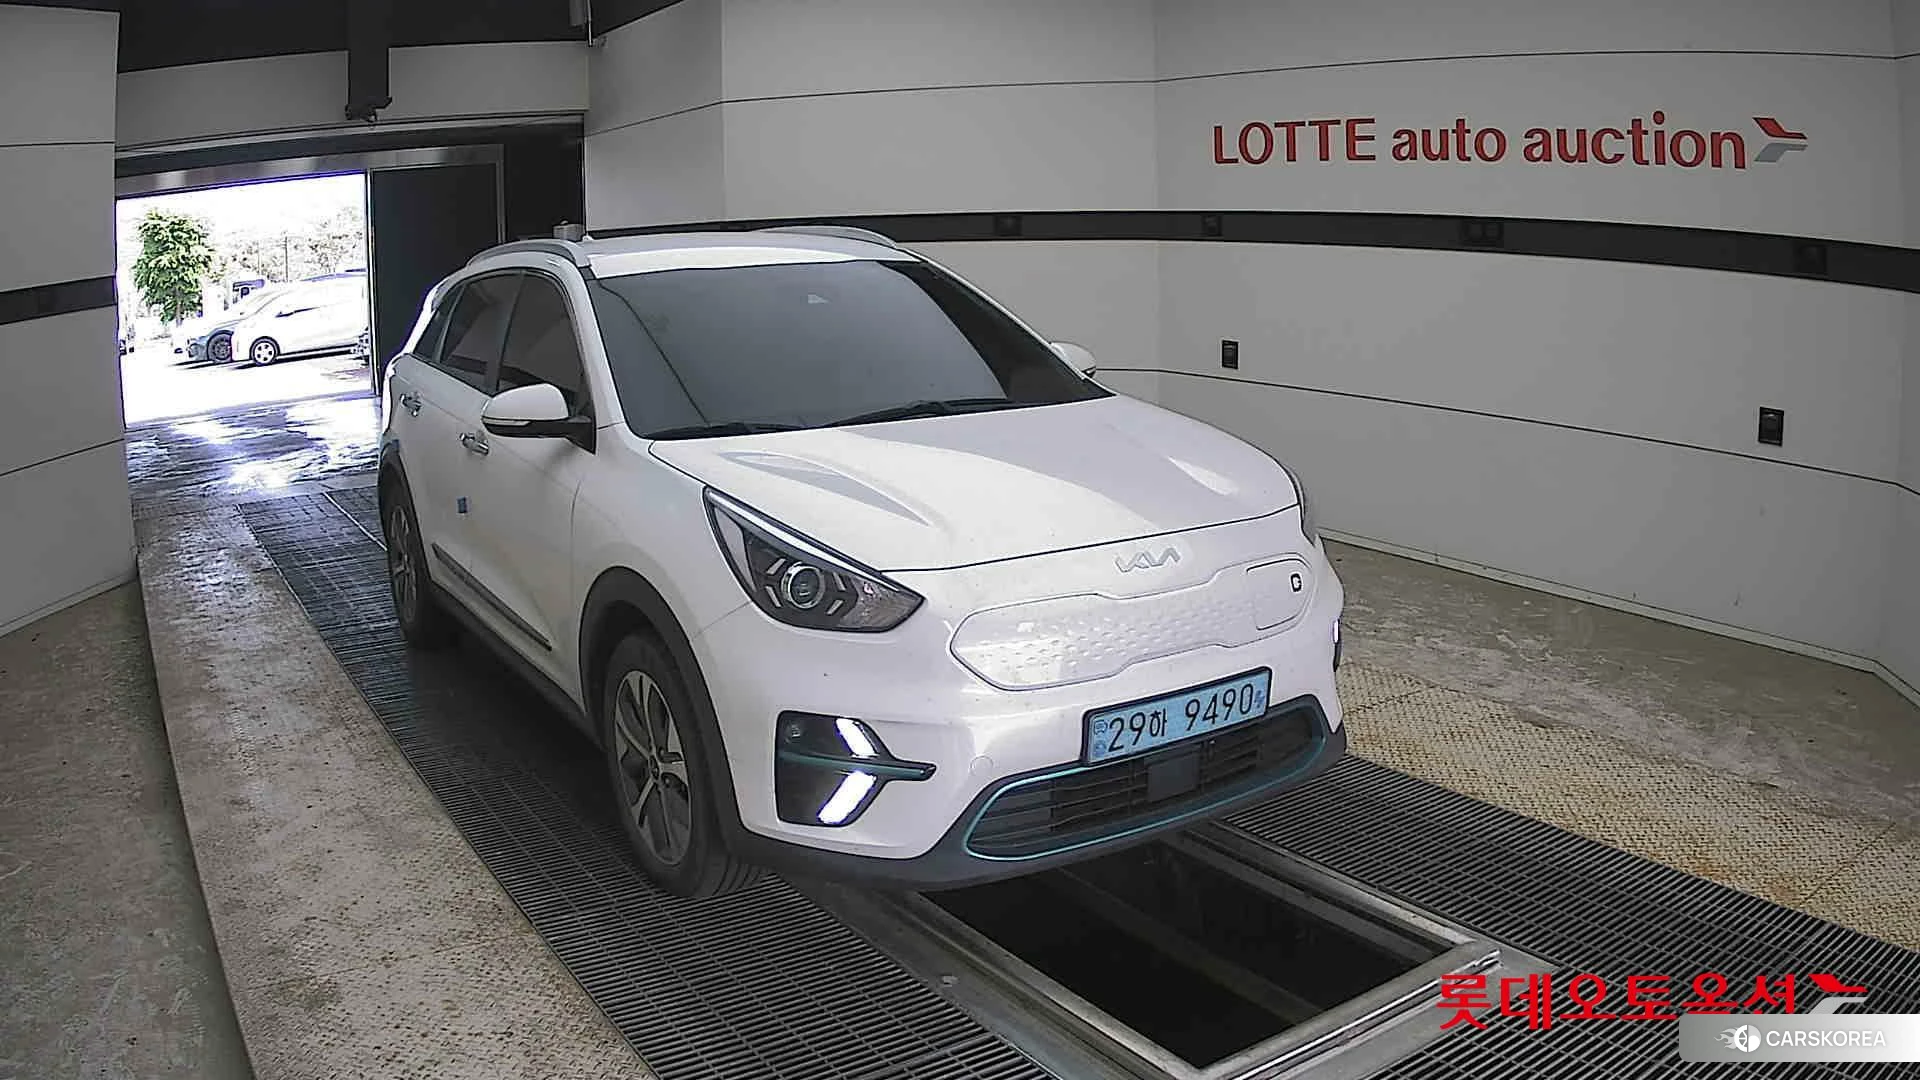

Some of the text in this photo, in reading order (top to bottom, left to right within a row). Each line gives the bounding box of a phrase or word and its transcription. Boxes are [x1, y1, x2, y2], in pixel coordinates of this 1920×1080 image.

[1213, 110, 1746, 169] LOTTE auto auction
[1108, 683, 1253, 752] 29하 9490
